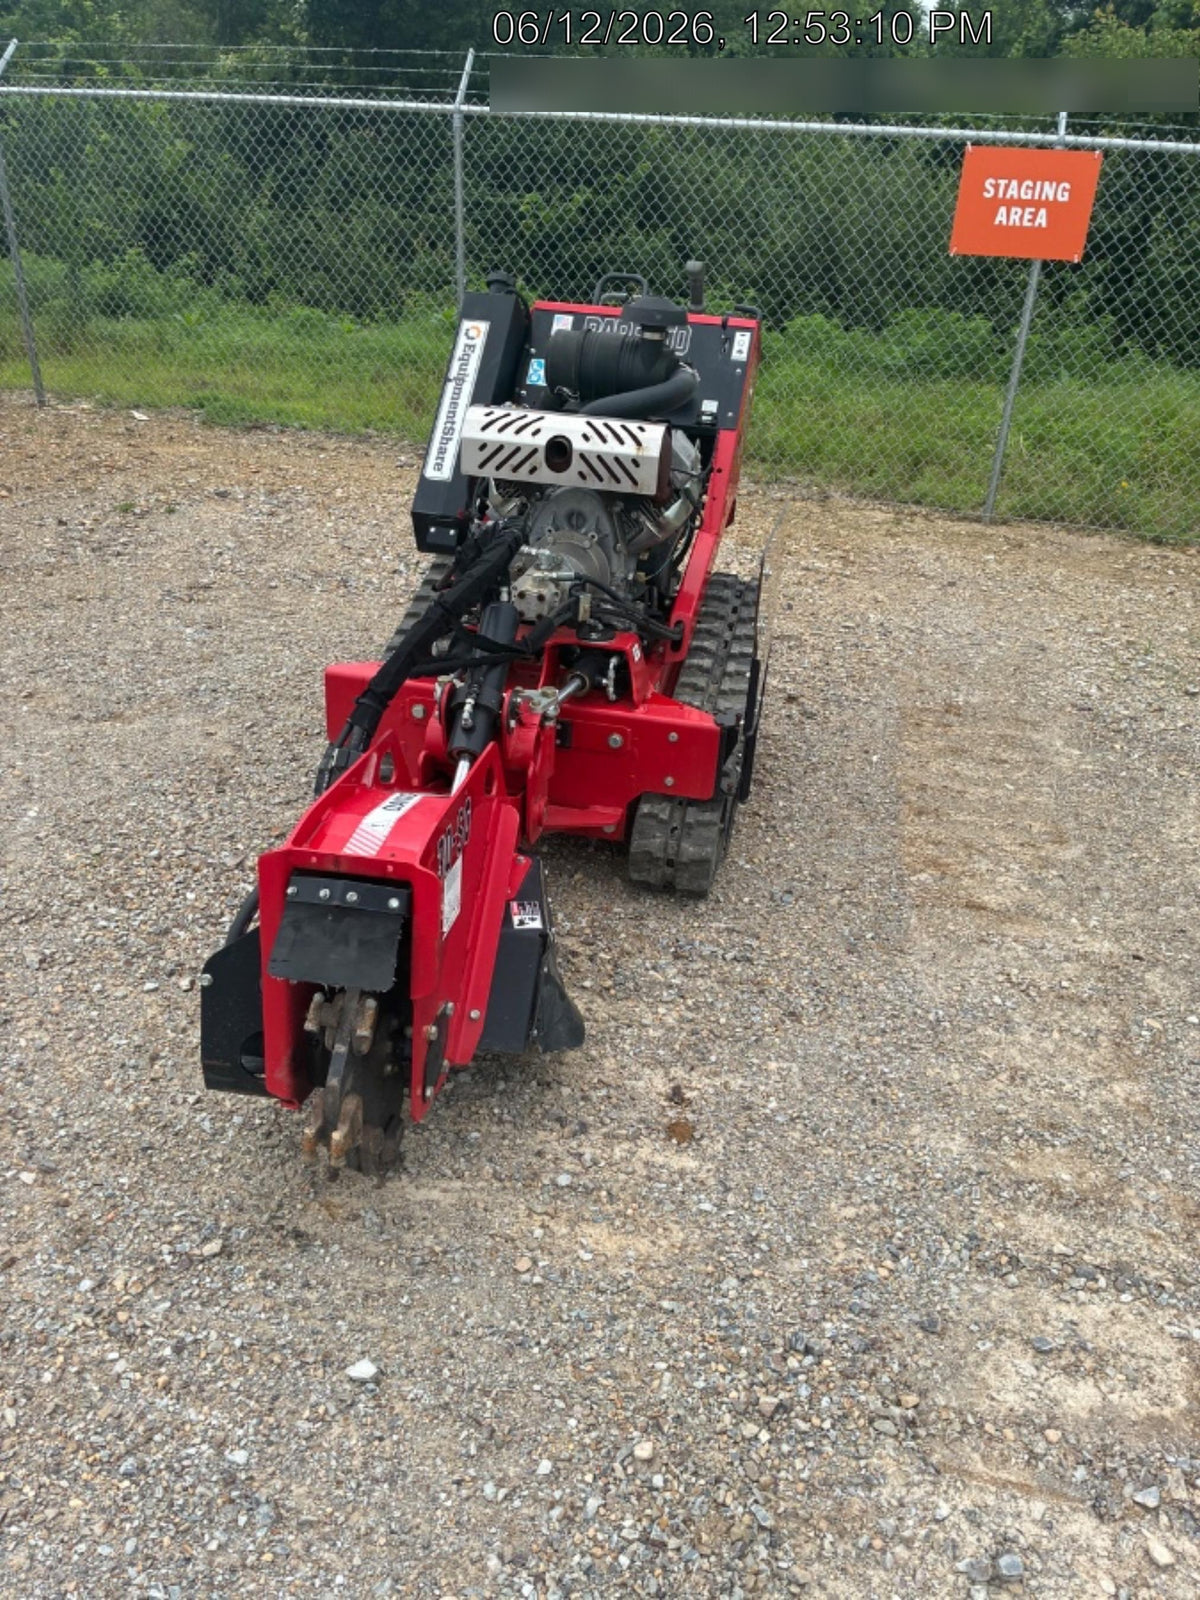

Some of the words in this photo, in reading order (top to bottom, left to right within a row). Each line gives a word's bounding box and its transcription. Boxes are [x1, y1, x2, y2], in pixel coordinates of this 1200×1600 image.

[983, 177, 1071, 202] STAGING
[994, 205, 1047, 228] AREA
[433, 343, 476, 472] EquipmentShare
